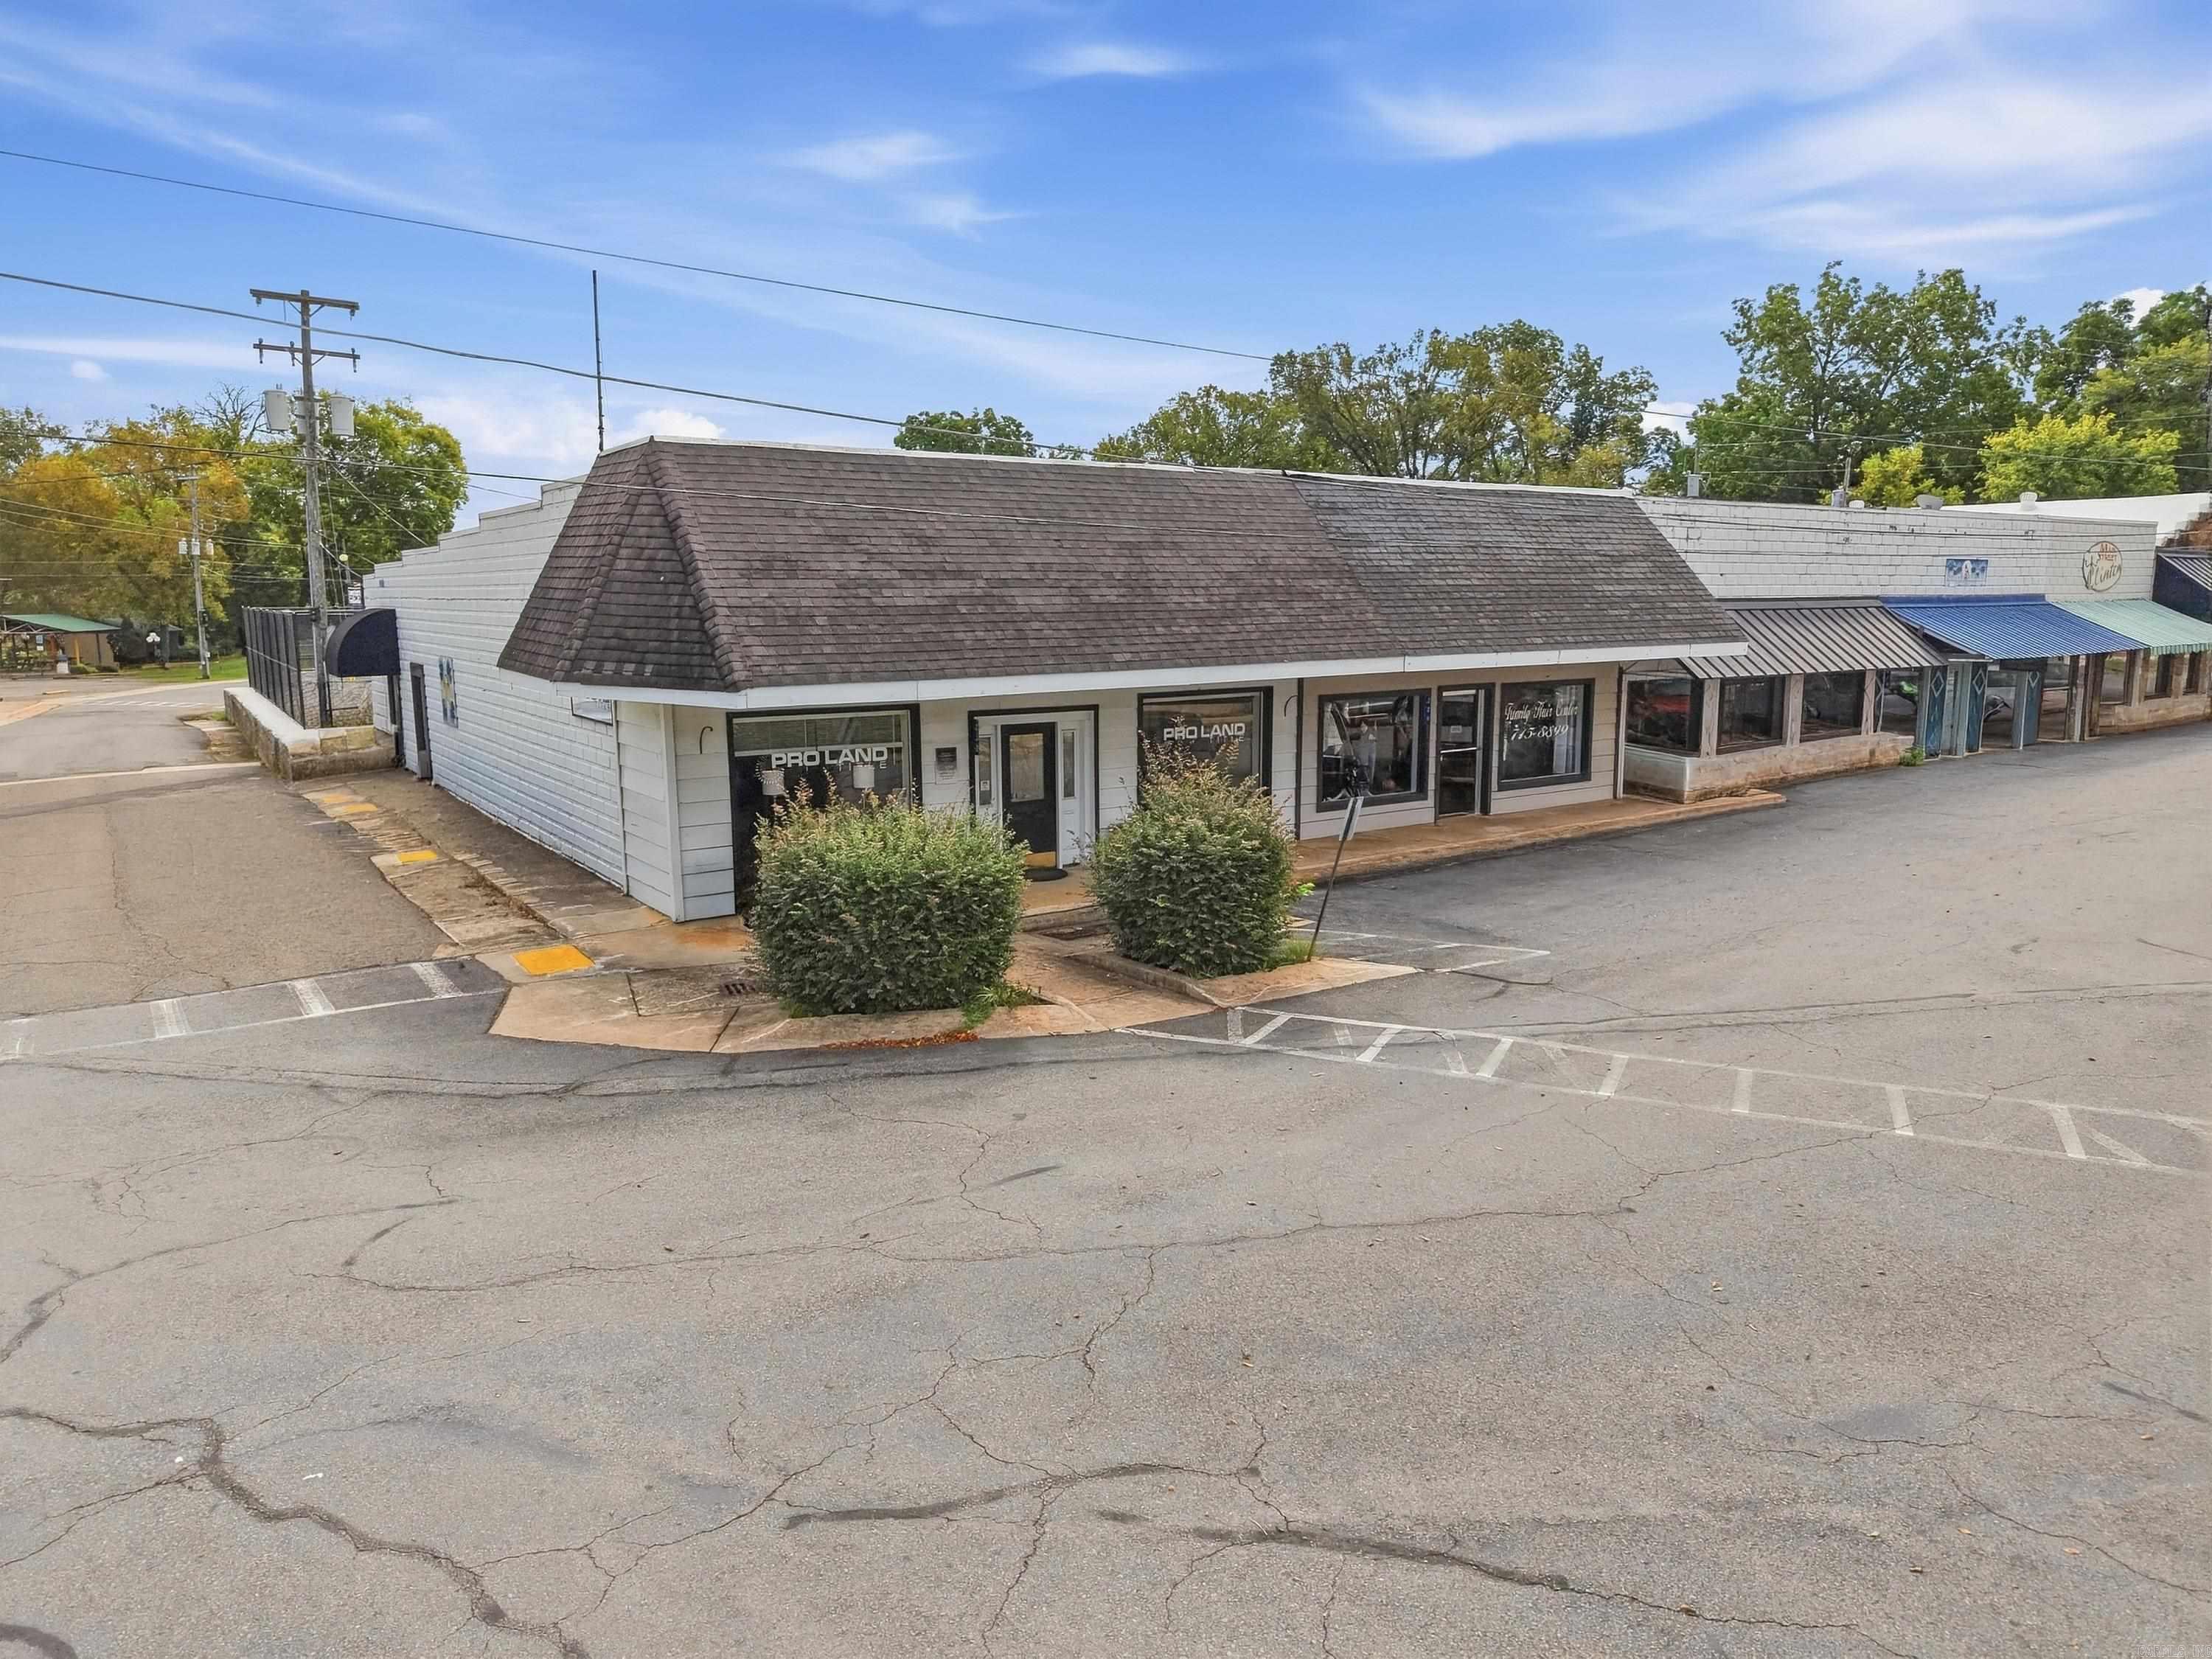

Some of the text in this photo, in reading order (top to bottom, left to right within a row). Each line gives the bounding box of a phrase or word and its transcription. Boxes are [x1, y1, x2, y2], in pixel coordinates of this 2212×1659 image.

[1505, 703, 1531, 725] Family
[1164, 723, 1245, 741] PRO LAND
[771, 747, 888, 768] PRO LAND
